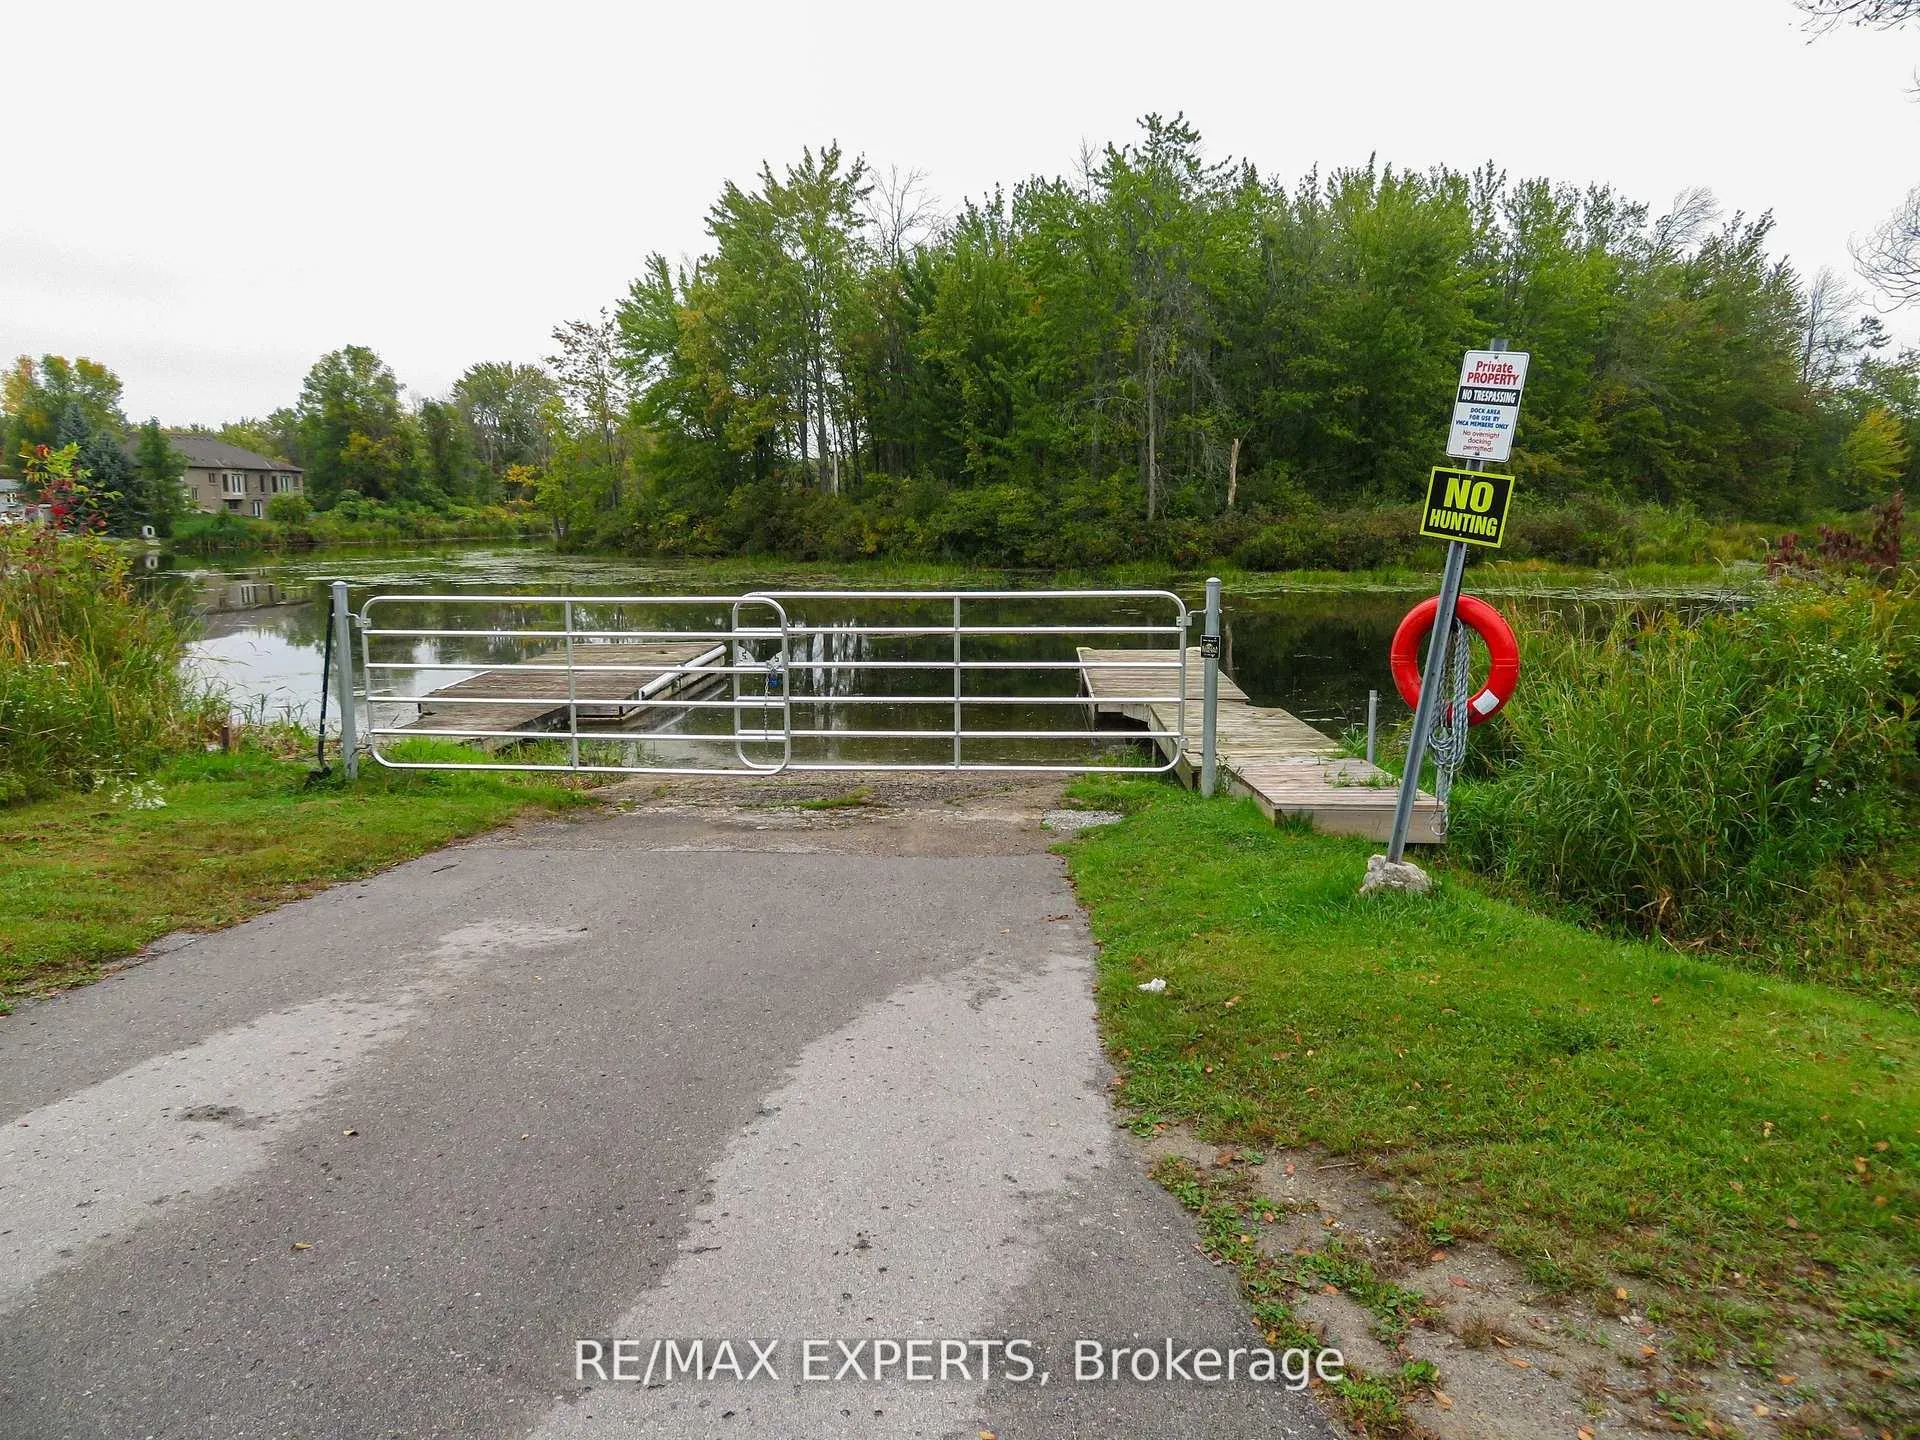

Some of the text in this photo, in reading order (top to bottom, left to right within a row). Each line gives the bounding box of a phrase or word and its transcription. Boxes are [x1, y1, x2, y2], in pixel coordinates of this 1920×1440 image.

[1476, 361, 1513, 373] Private
[1467, 372, 1519, 385] PROPERTY
[1462, 388, 1516, 403] NO TRESPASSING
[1467, 437, 1492, 446] docking
[1472, 431, 1500, 439] overnight
[1443, 477, 1495, 513] NO
[1429, 508, 1498, 537] HUNTING
